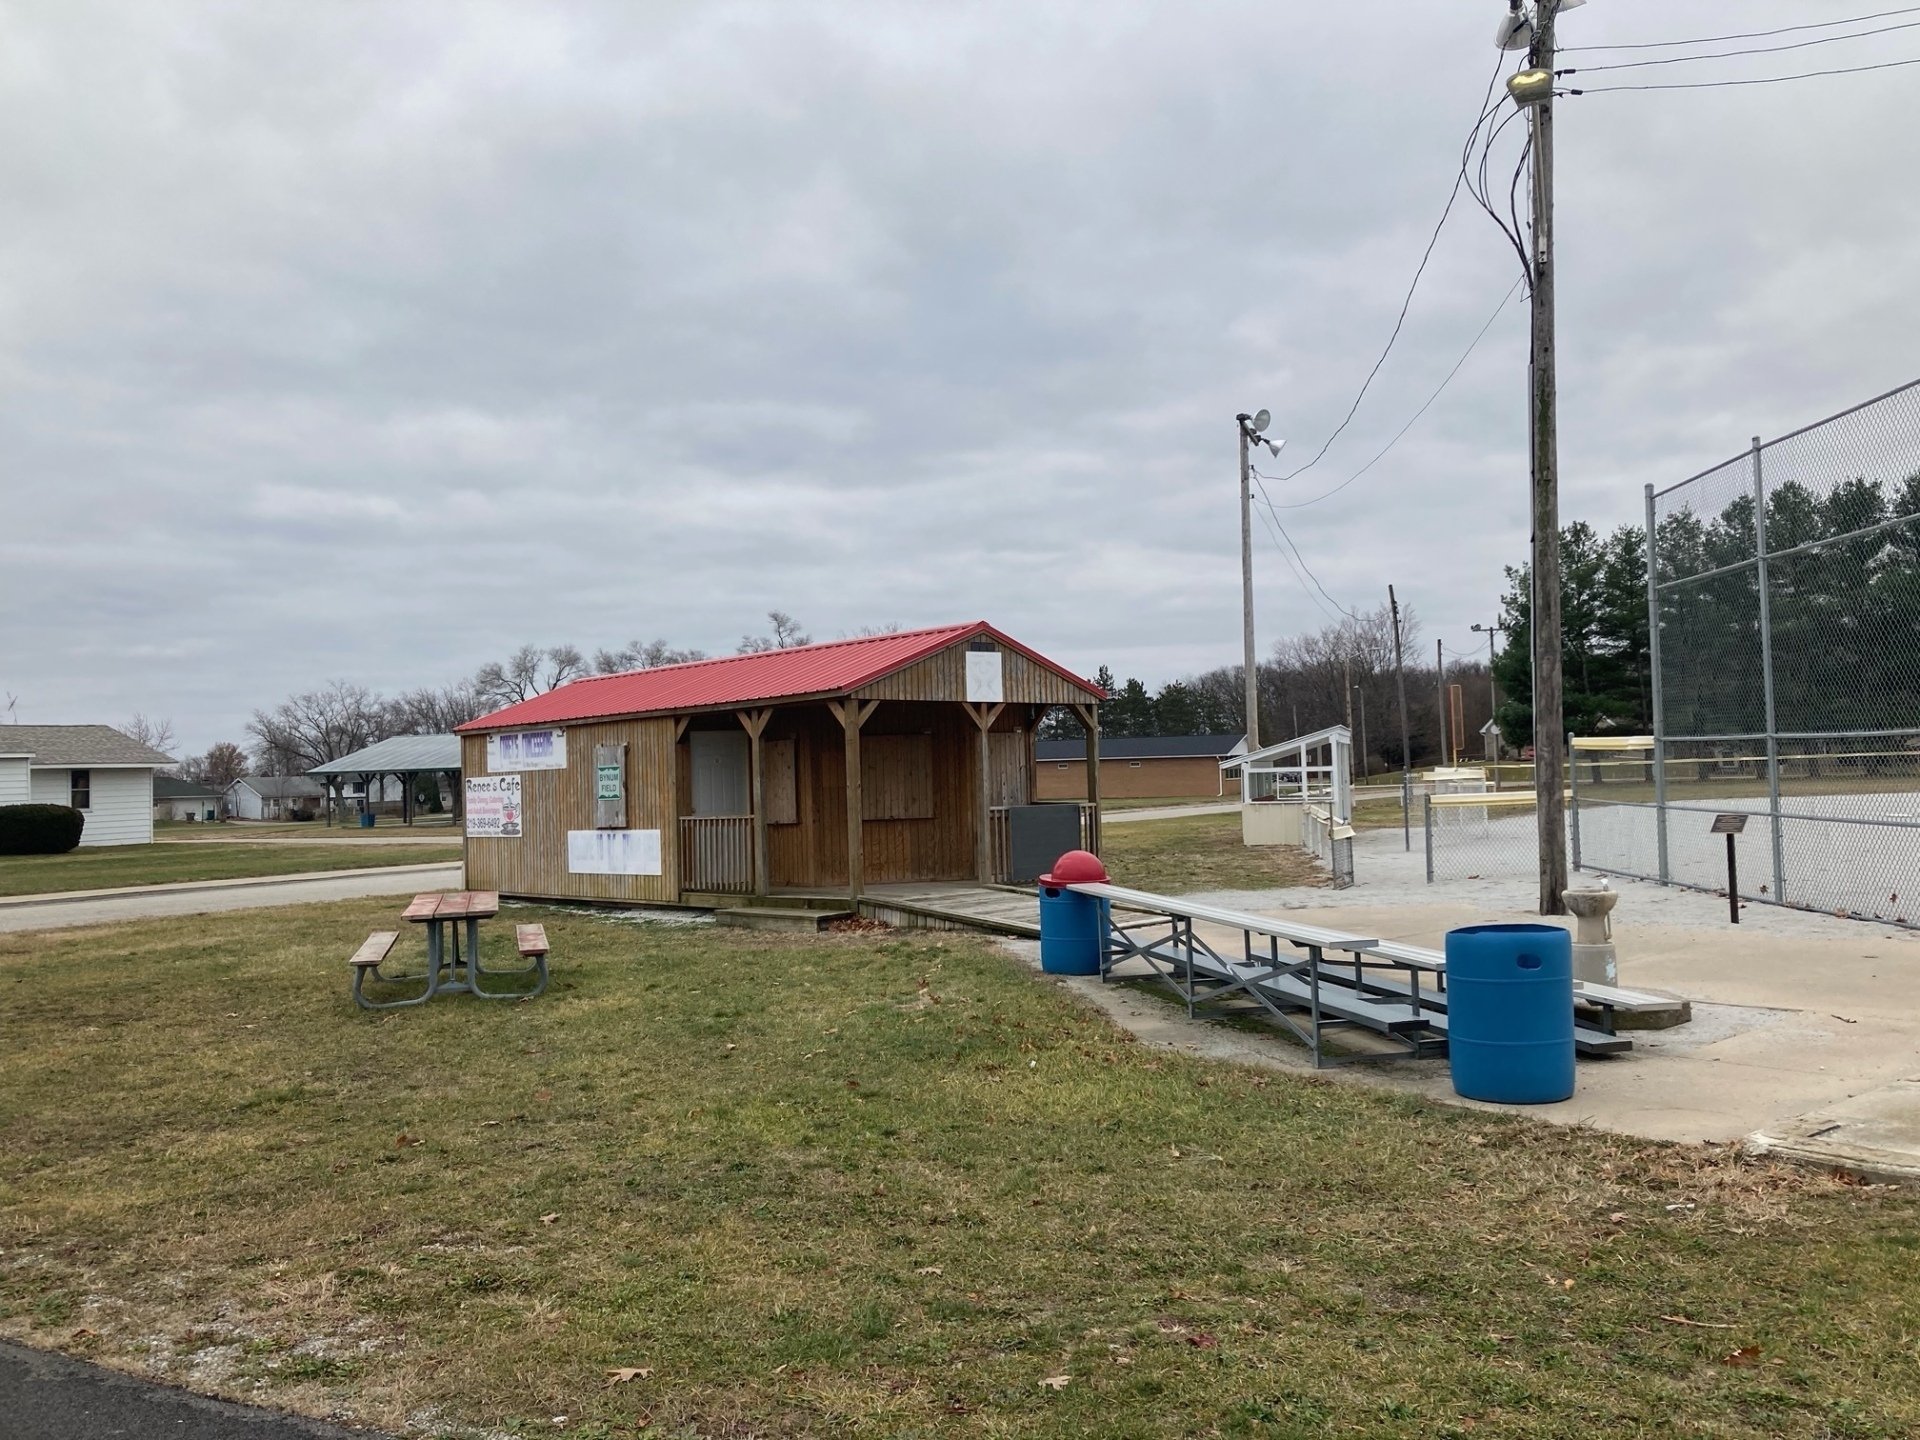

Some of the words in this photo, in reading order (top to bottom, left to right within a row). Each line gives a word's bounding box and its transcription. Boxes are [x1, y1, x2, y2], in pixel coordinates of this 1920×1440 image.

[600, 774, 619, 782] BYNUM
[466, 778, 497, 792] Renee's
[500, 777, 520, 795] Cafe
[601, 784, 617, 792] FIELD
